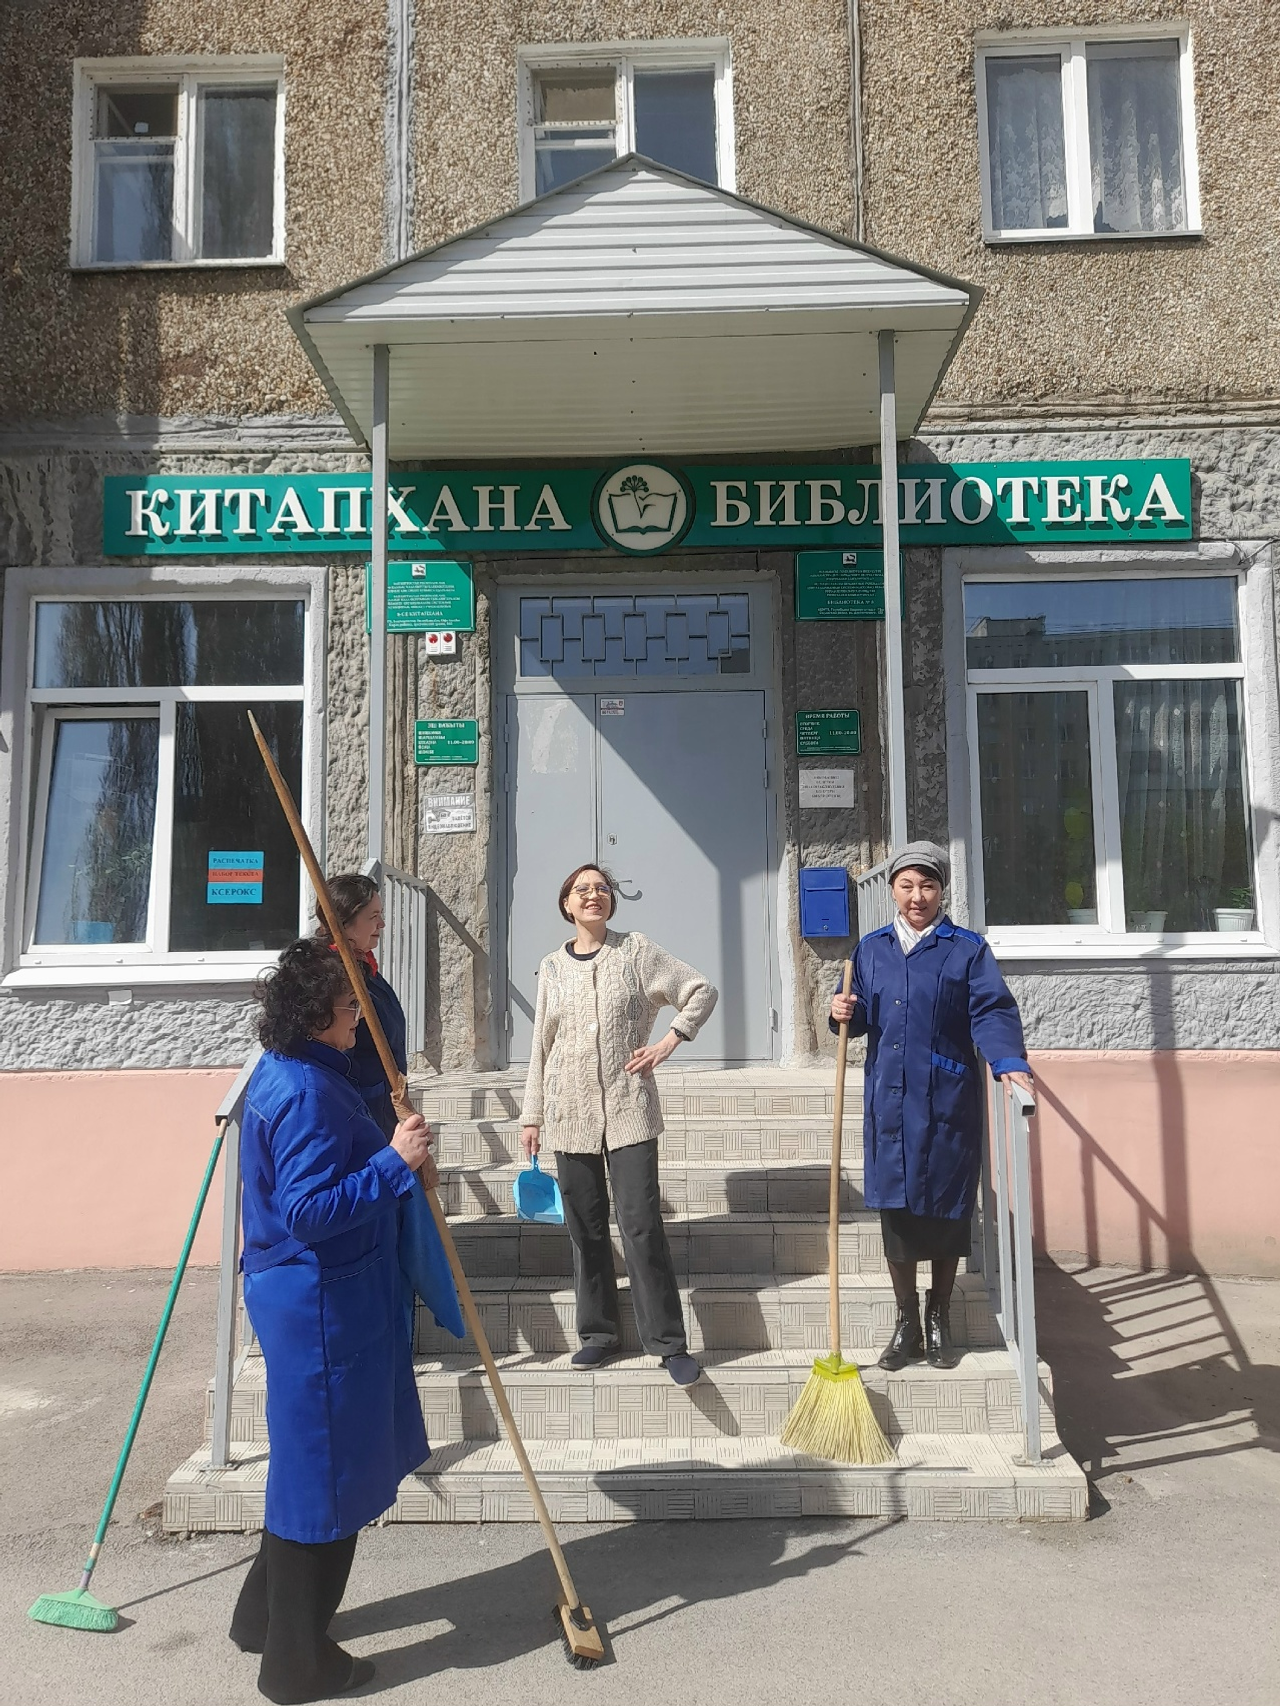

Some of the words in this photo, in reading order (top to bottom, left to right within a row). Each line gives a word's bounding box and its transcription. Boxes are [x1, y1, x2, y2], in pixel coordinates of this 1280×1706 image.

[124, 483, 572, 536] КИТАПХАНА
[709, 473, 1185, 528] БИБЛИОТЕКА
[428, 795, 471, 807] ВНИМАНИЕ
[211, 888, 257, 896] КСЕРОКС
